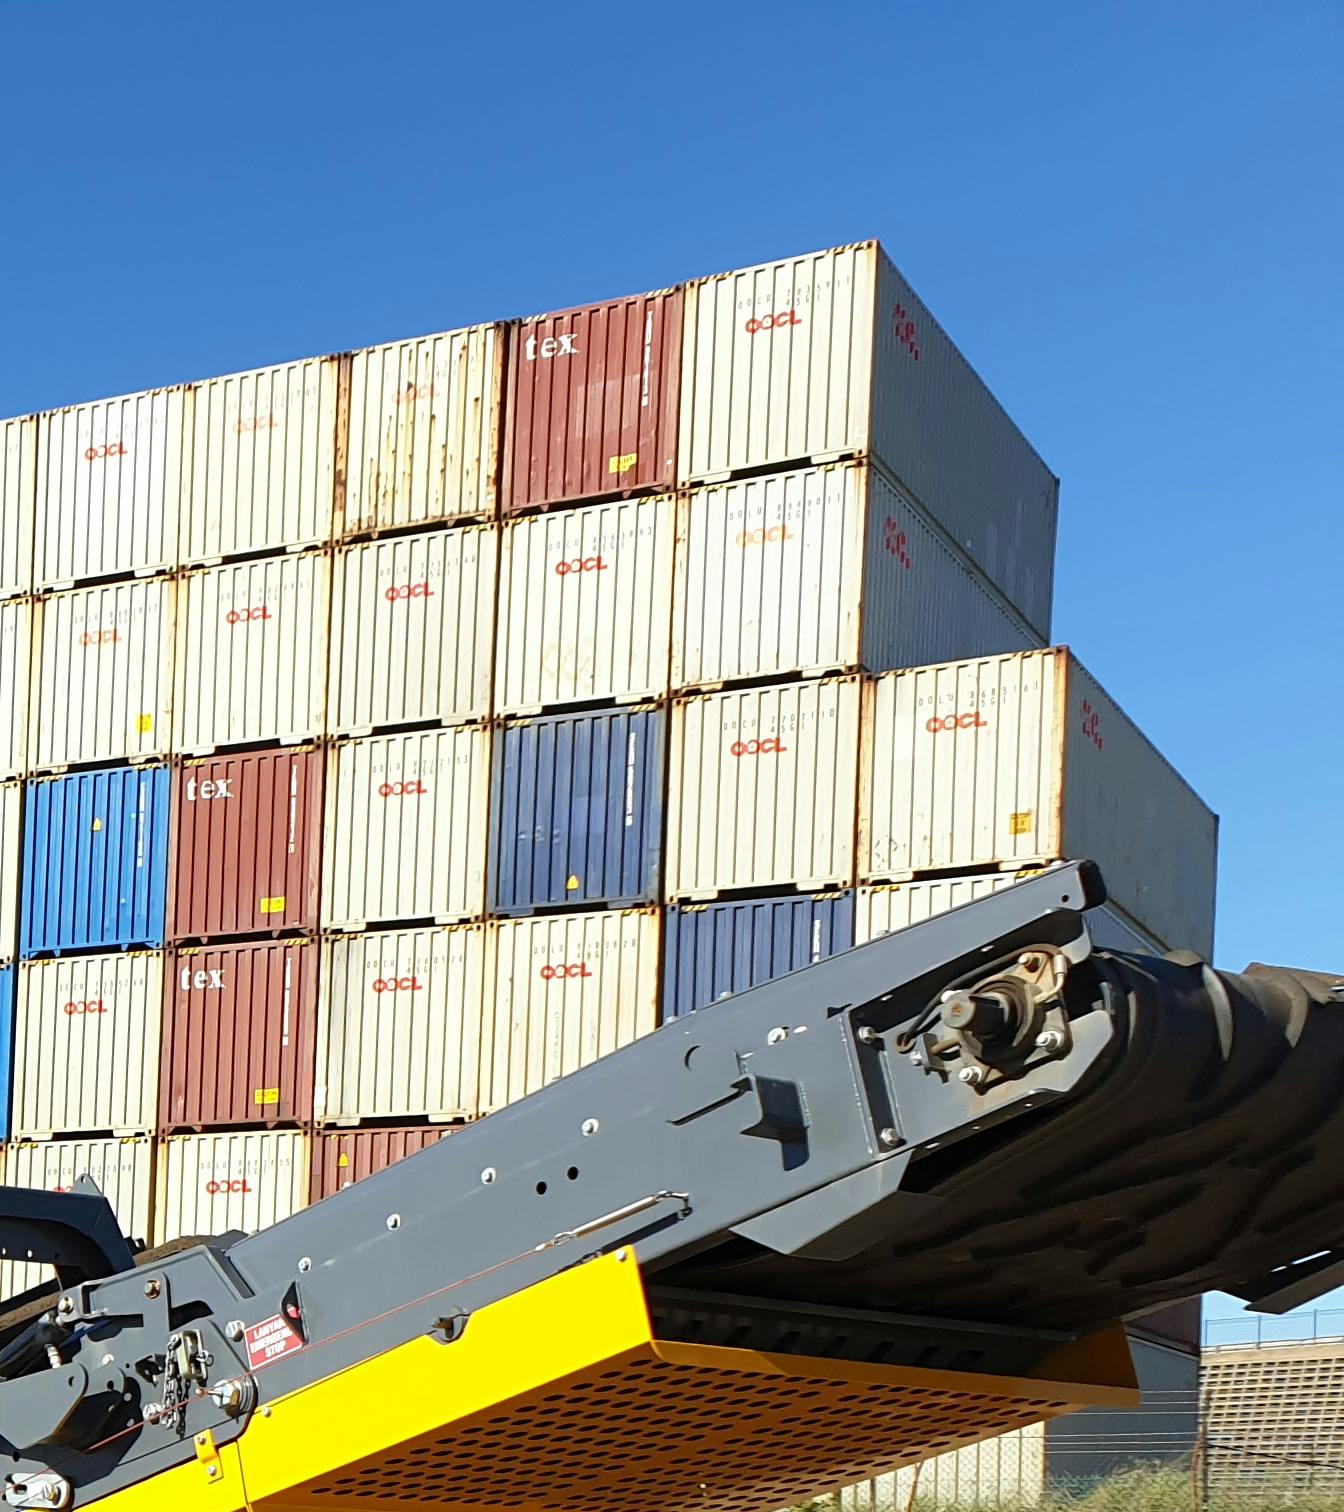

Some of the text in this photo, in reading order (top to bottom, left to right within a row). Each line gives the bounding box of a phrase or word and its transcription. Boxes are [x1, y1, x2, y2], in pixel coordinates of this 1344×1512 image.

[745, 307, 801, 335] OOCL
[525, 331, 580, 362] tex
[85, 442, 127, 461] OOCL
[556, 555, 608, 576] OOCL
[385, 582, 435, 603] OOCL
[226, 606, 272, 625] OOCL
[80, 629, 122, 649] OOCL
[927, 710, 991, 734] OOCL
[731, 737, 787, 758] OOCL
[186, 774, 235, 801] tex
[378, 779, 428, 798] OOCL
[180, 964, 226, 991] tex
[541, 962, 592, 982] OOCL
[372, 976, 423, 993] OOCL
[64, 998, 106, 1017] OOCL
[207, 1179, 252, 1195] OOCL
[264, 1340, 287, 1358] STOP
